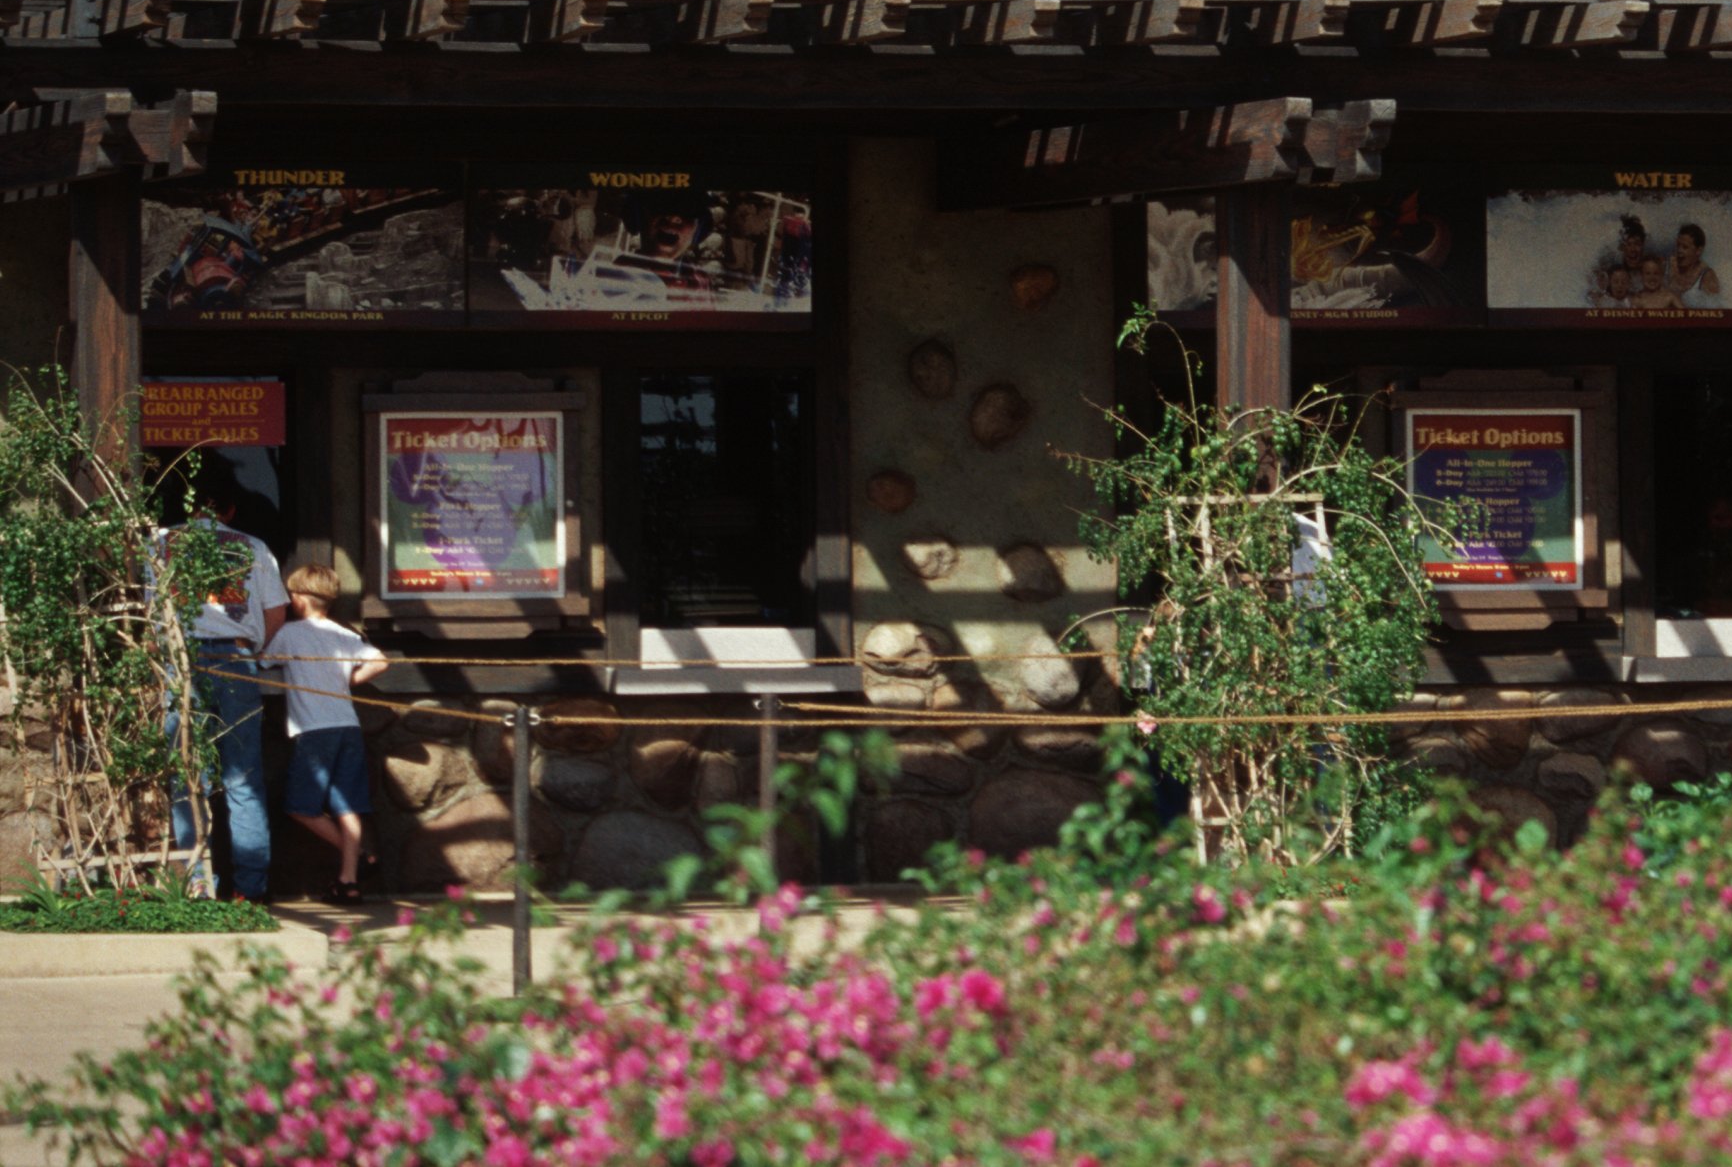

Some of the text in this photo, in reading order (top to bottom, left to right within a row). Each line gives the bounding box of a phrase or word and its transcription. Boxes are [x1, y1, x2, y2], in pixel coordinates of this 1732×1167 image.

[234, 169, 345, 186] THUNDER
[589, 172, 690, 188] WONDER
[1614, 171, 1693, 189] WATER
[199, 310, 385, 321] AT THE MAGIC KINGDOM PARK
[611, 312, 670, 321] AT EPCOT
[1352, 310, 1399, 319] STUDIOS
[1586, 309, 1725, 319] AT DISNEY WATER PARKS
[143, 402, 259, 416] GROUP SALES
[192, 417, 212, 426] and
[144, 427, 260, 441] TICKET SALES
[1416, 427, 1565, 449] Ticket Options
[391, 431, 548, 452] Ticket Options
[1498, 459, 1534, 469] Hopper
[1493, 530, 1523, 539] Ticket
